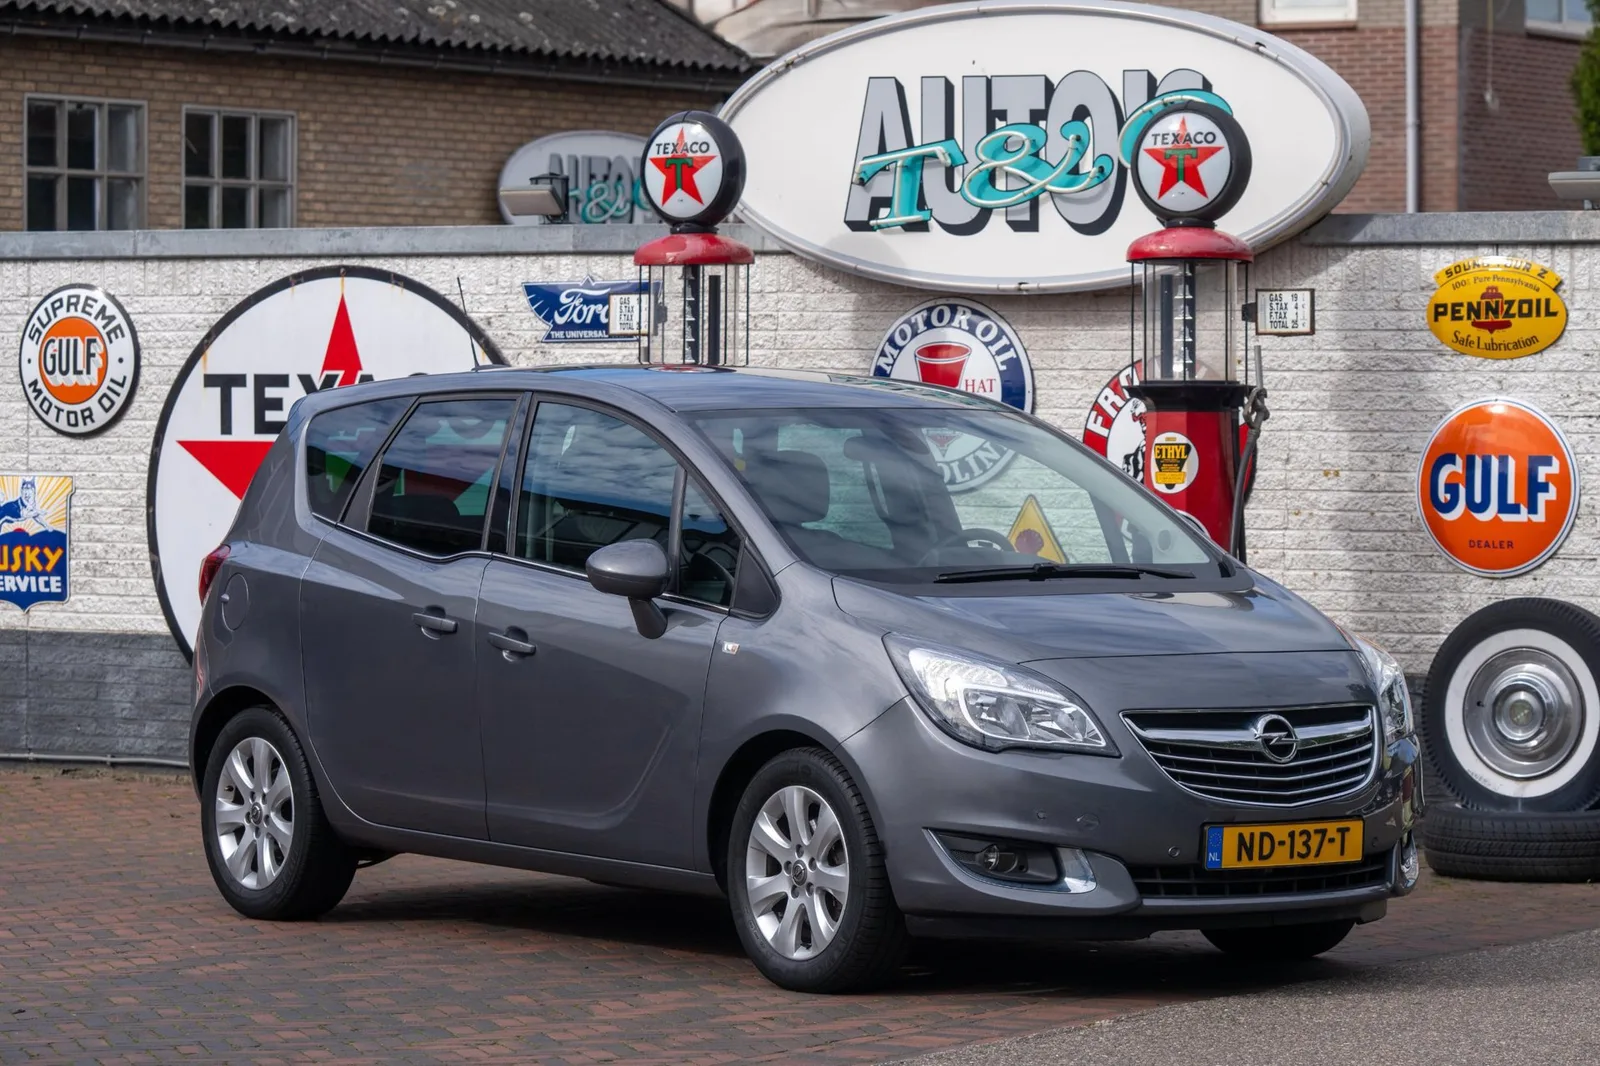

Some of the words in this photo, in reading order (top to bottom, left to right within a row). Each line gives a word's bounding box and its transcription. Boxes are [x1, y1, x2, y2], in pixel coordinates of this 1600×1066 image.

[1151, 131, 1217, 146] TEXACO
[656, 141, 710, 155] TEXACO
[1537, 268, 1548, 279] Z
[1473, 275, 1491, 285] Pure
[1492, 274, 1540, 293] Pennsylvania
[1269, 293, 1283, 302] GAS
[1433, 298, 1559, 322] PENNZOIL
[28, 294, 125, 345] SUPREME
[1269, 320, 1289, 329] TOTAL
[550, 330, 565, 339] THE
[566, 329, 609, 339] UNIVERSAL
[877, 305, 972, 374] MOTOR
[975, 319, 1017, 371] OIL
[1451, 330, 1475, 349] Safe
[1477, 335, 1539, 352] Lubrication
[43, 336, 103, 385] GULF
[964, 378, 996, 393] HAT
[28, 379, 95, 427] MOTOR
[98, 375, 127, 413] OIL
[1154, 445, 1188, 459] ETHYL
[1429, 452, 1560, 522] GULF
[1468, 539, 1514, 549] DEALER
[1236, 826, 1352, 863] ND-137-T
[1208, 851, 1221, 862] NL
